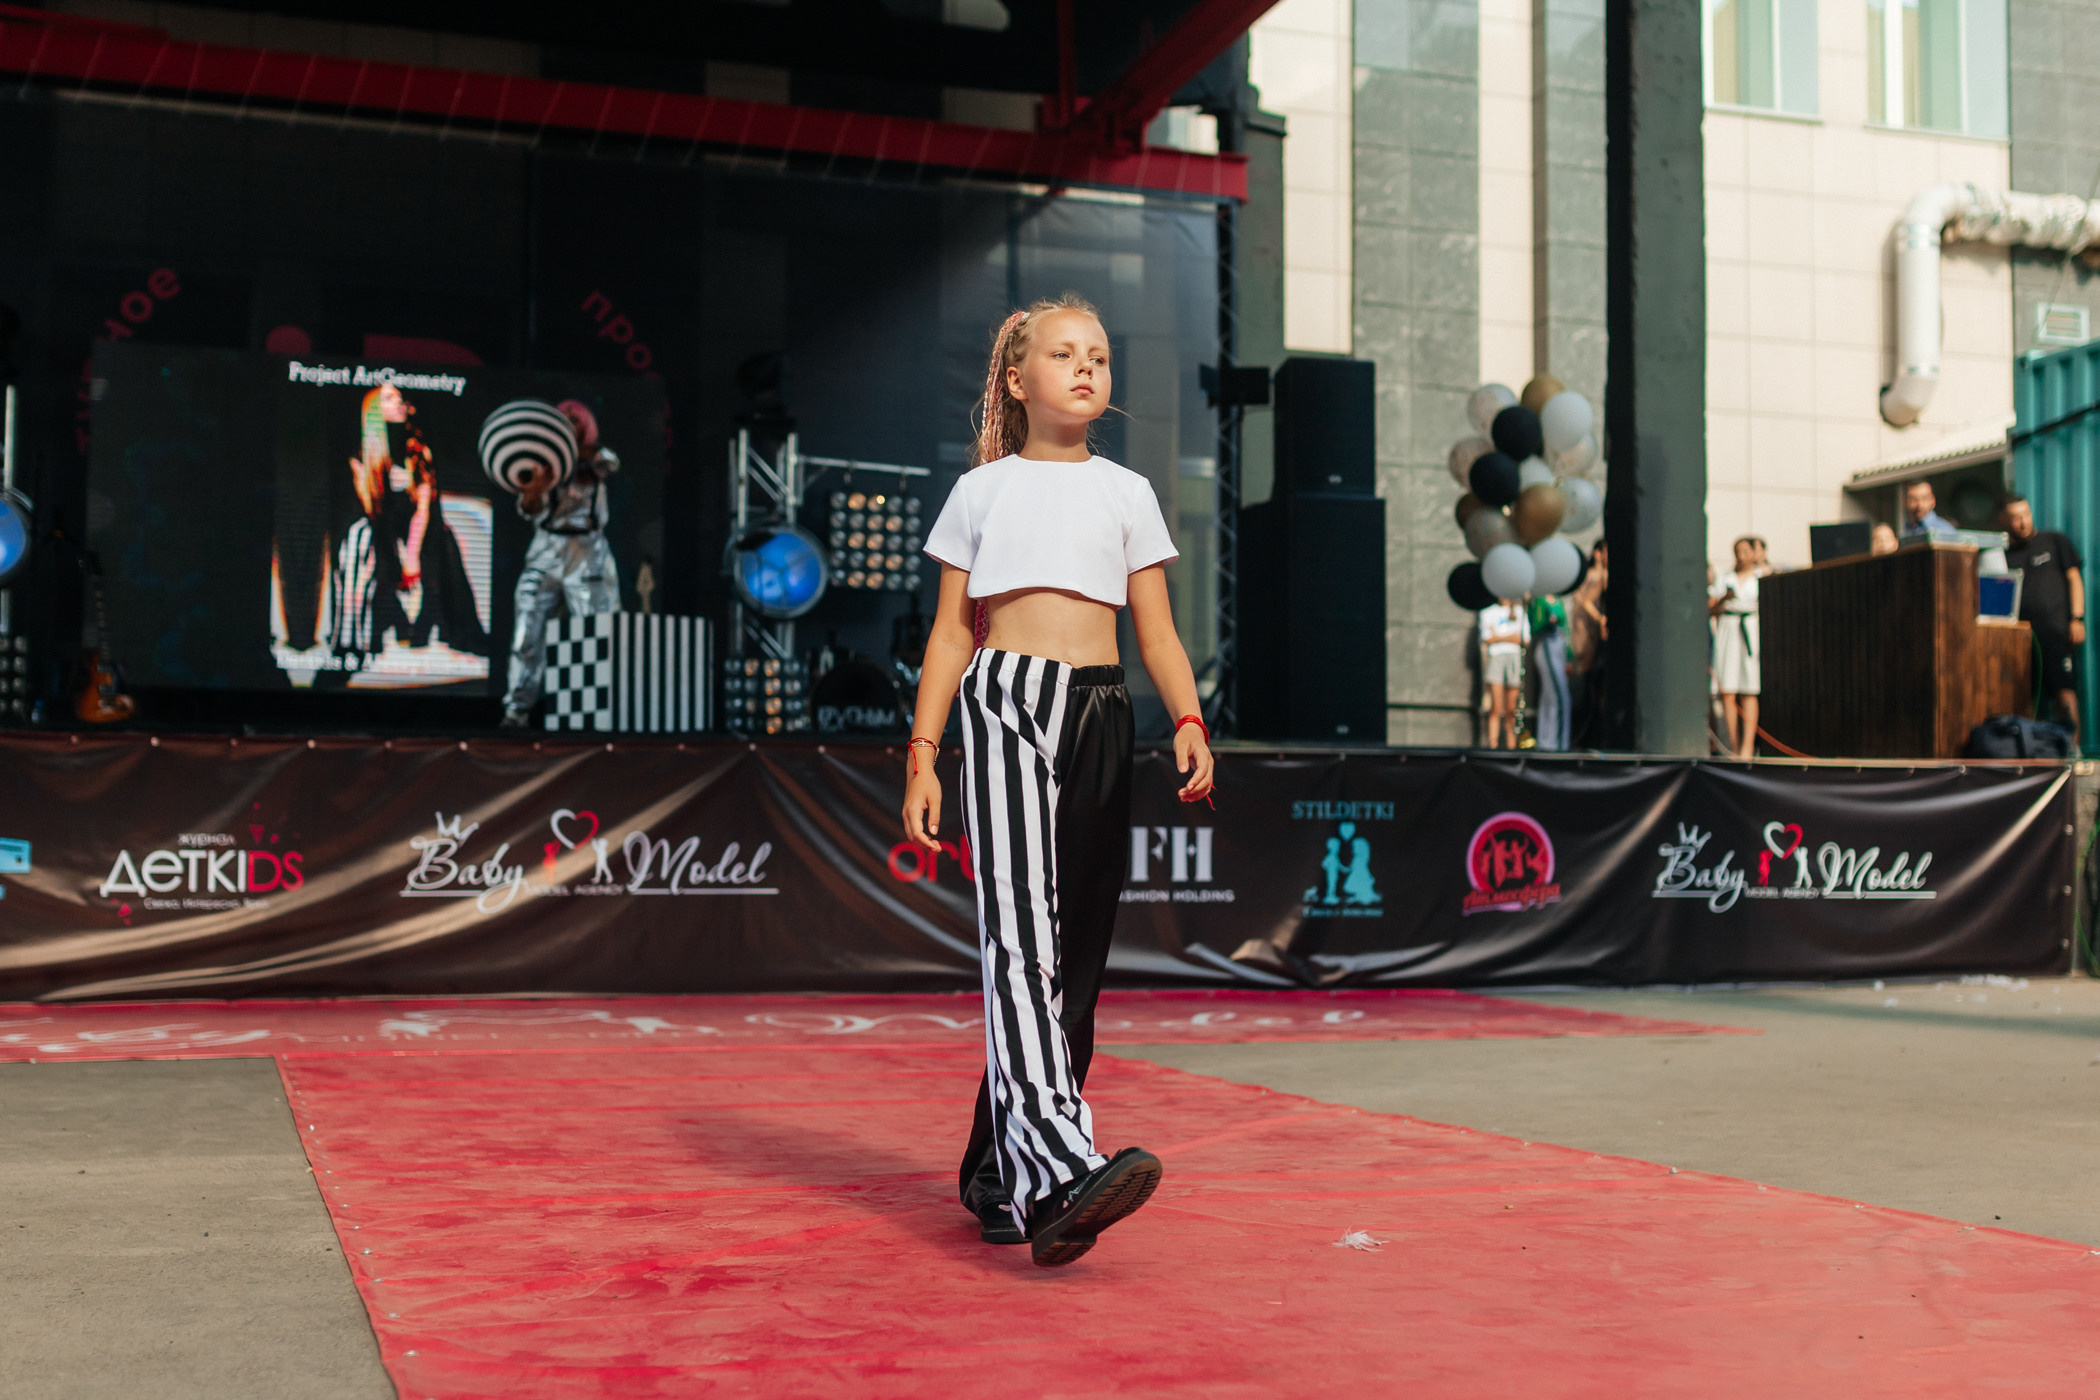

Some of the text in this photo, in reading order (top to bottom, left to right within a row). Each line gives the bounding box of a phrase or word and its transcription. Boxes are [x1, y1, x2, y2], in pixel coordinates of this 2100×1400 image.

[288, 360, 466, 396] Project ArtGeometry
[405, 830, 773, 914] Baby Model
[1172, 890, 1236, 903] HOLDING
[1657, 841, 1933, 912] Baby Model
